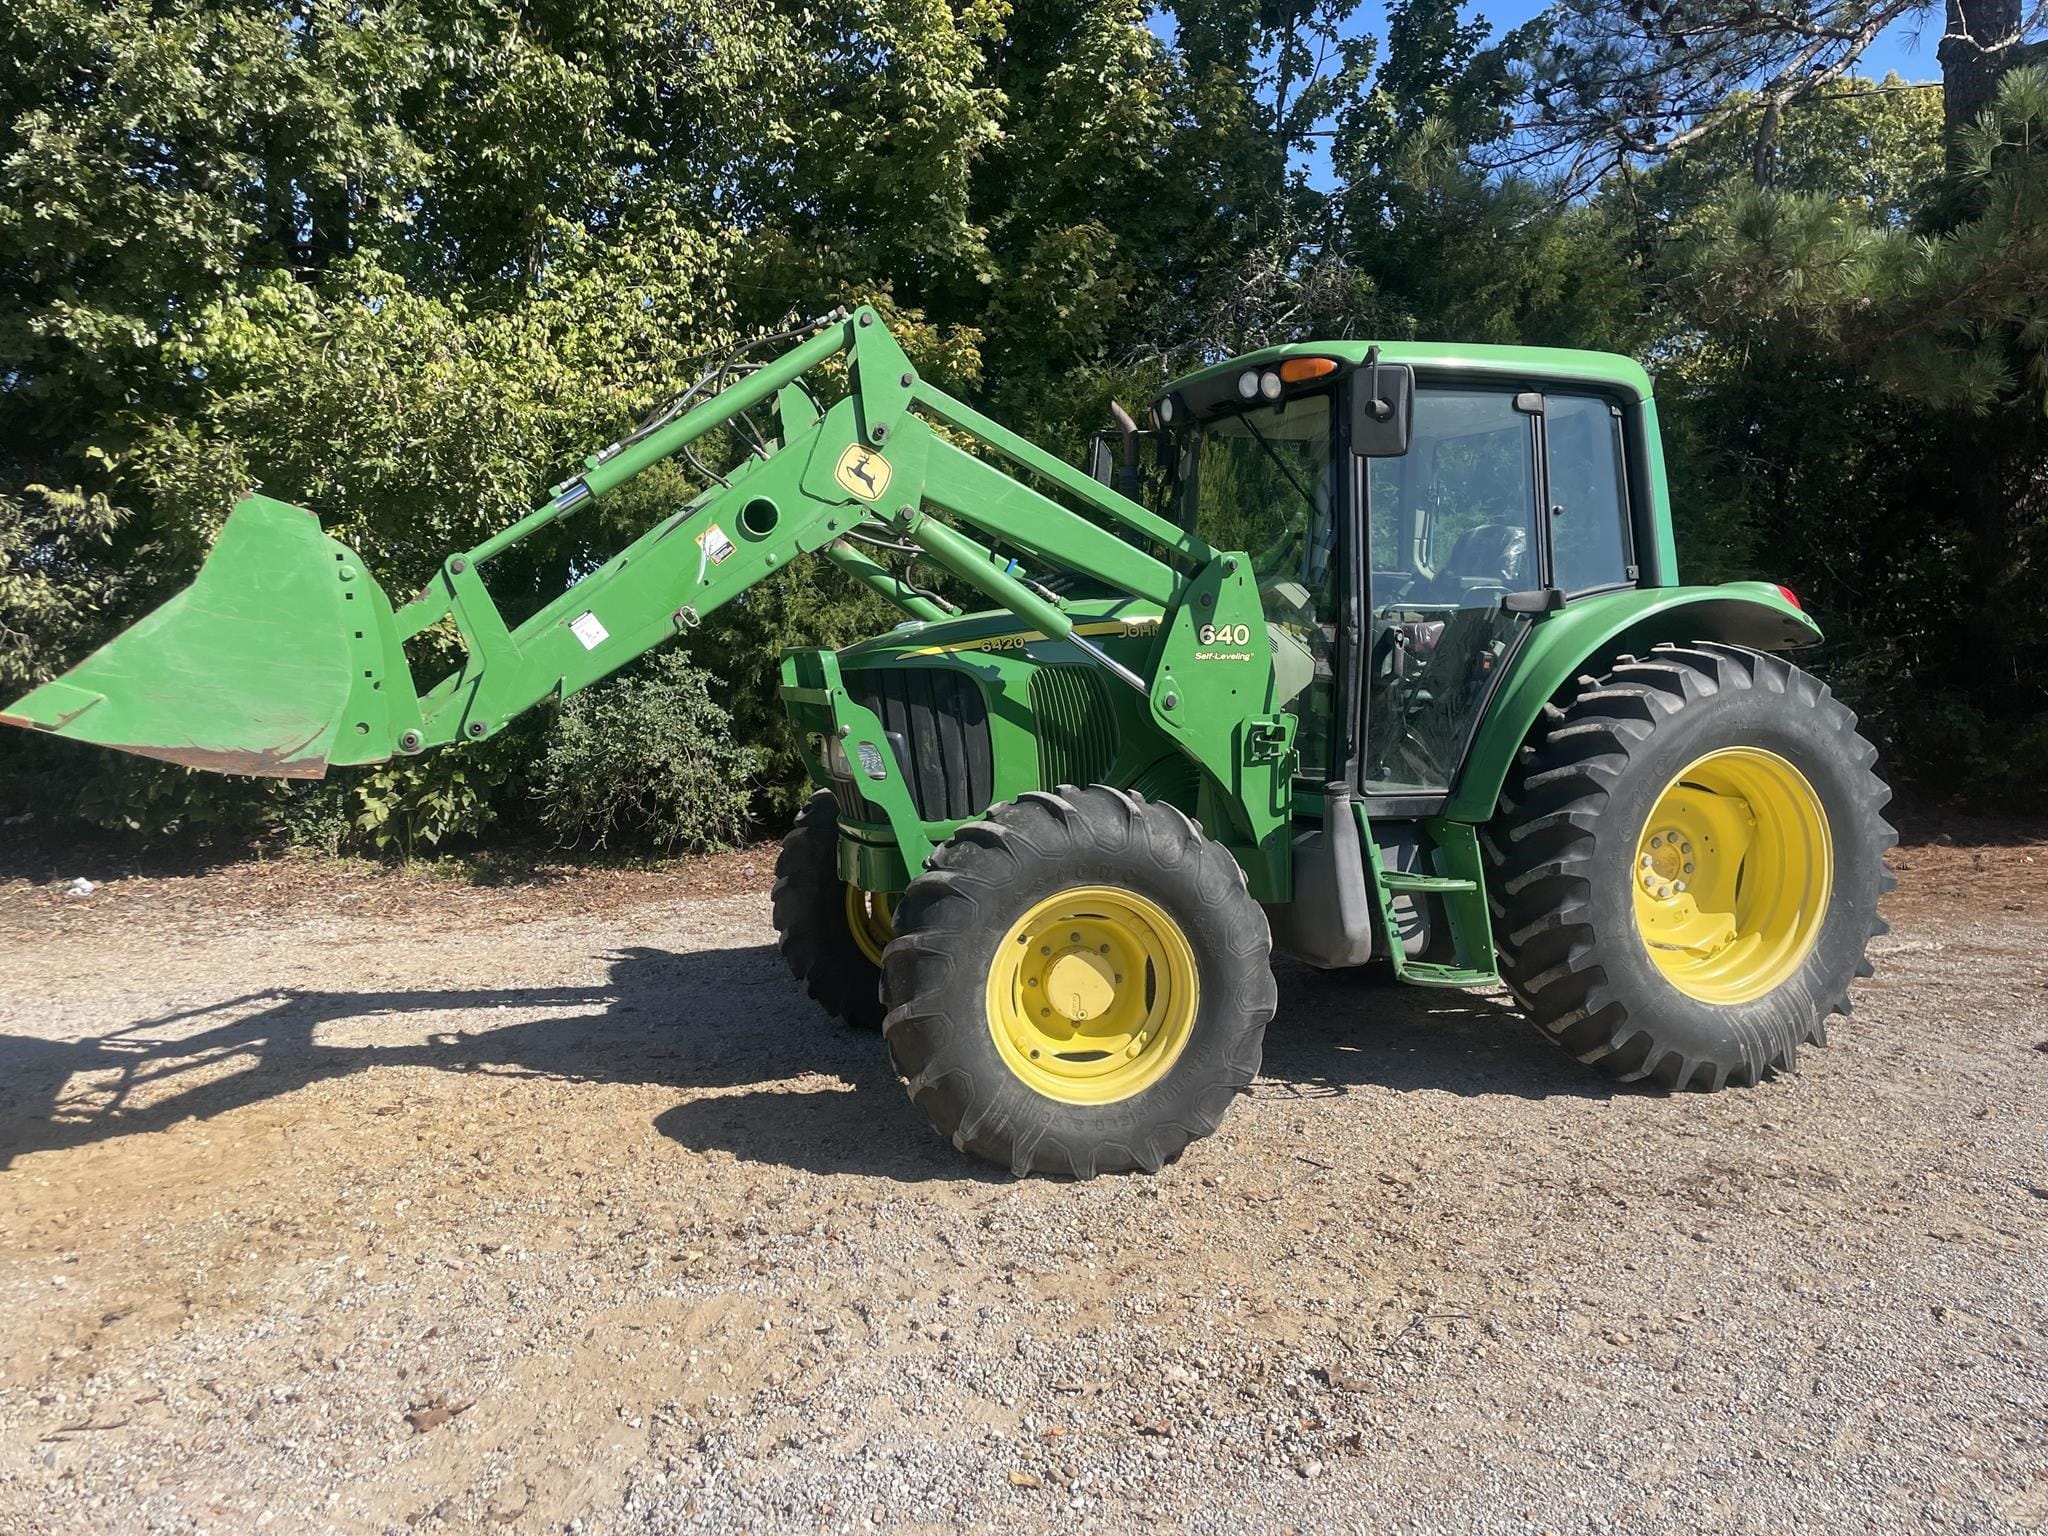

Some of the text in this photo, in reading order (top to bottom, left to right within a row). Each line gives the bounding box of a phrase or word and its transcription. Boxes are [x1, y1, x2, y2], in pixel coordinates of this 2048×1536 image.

[1199, 623, 1250, 646] 640
[981, 636, 1025, 652] 6420
[1194, 651, 1251, 662] Self-Leveling
